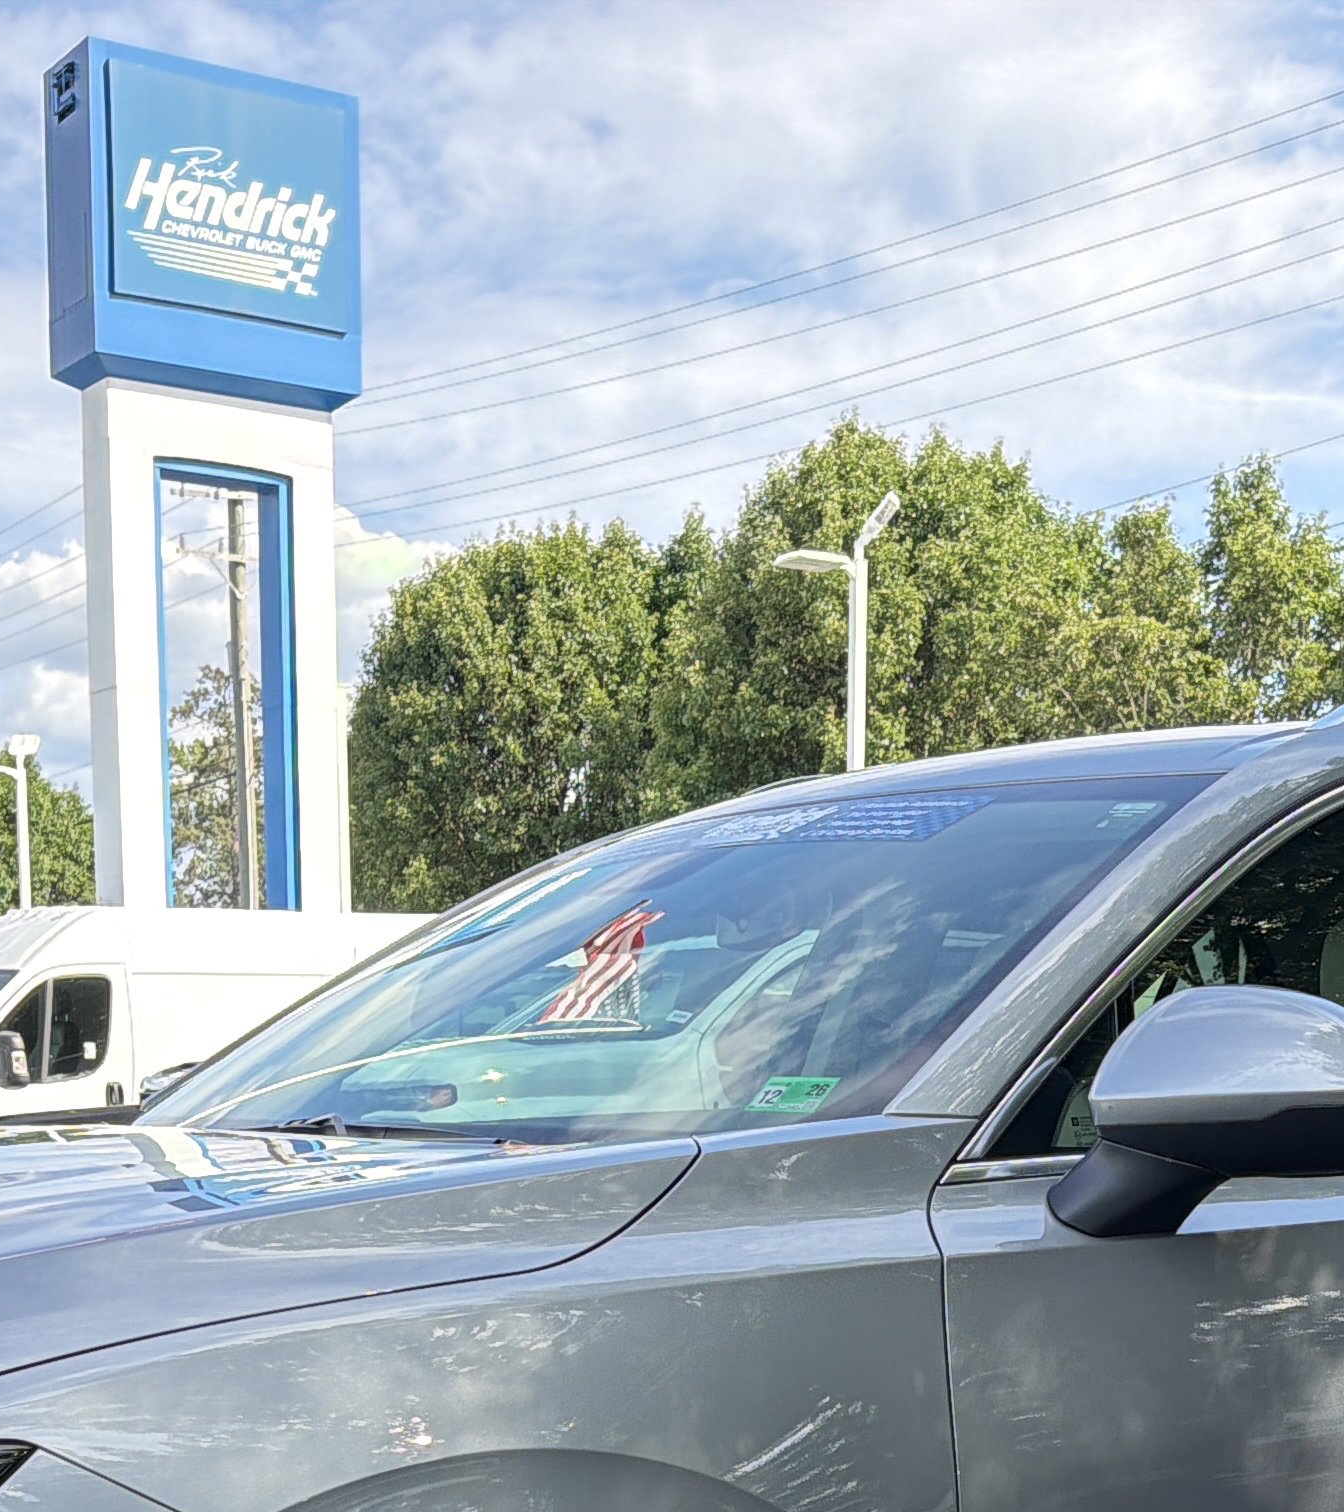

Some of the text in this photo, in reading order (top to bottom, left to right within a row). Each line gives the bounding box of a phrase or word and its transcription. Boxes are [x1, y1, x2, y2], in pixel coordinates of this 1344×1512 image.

[170, 146, 239, 189] Rick
[124, 157, 337, 247] Hendrick
[161, 219, 323, 262] CHEVROLET BUICK GMC
[758, 1089, 783, 1104] 12
[804, 1083, 831, 1097] 26
